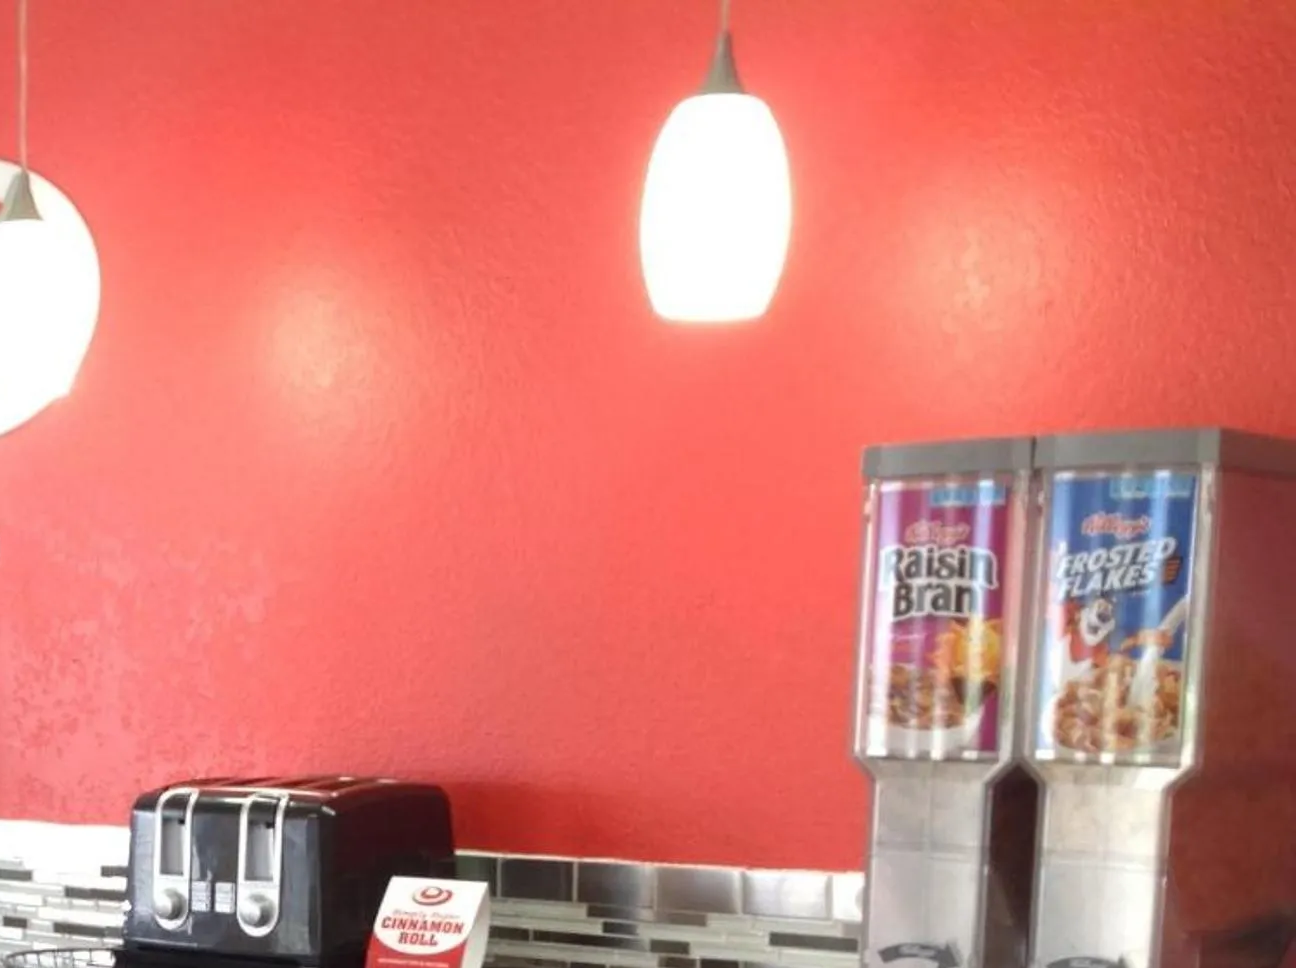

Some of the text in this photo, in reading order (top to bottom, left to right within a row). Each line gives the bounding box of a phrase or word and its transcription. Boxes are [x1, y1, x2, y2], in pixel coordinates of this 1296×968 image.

[882, 545, 997, 590] Raisin
[1056, 537, 1177, 580] FROSTED
[1058, 562, 1157, 600] FLAKES
[891, 581, 980, 620] Bran
[381, 916, 464, 935] CINNAMON
[398, 931, 438, 947] ROLL
